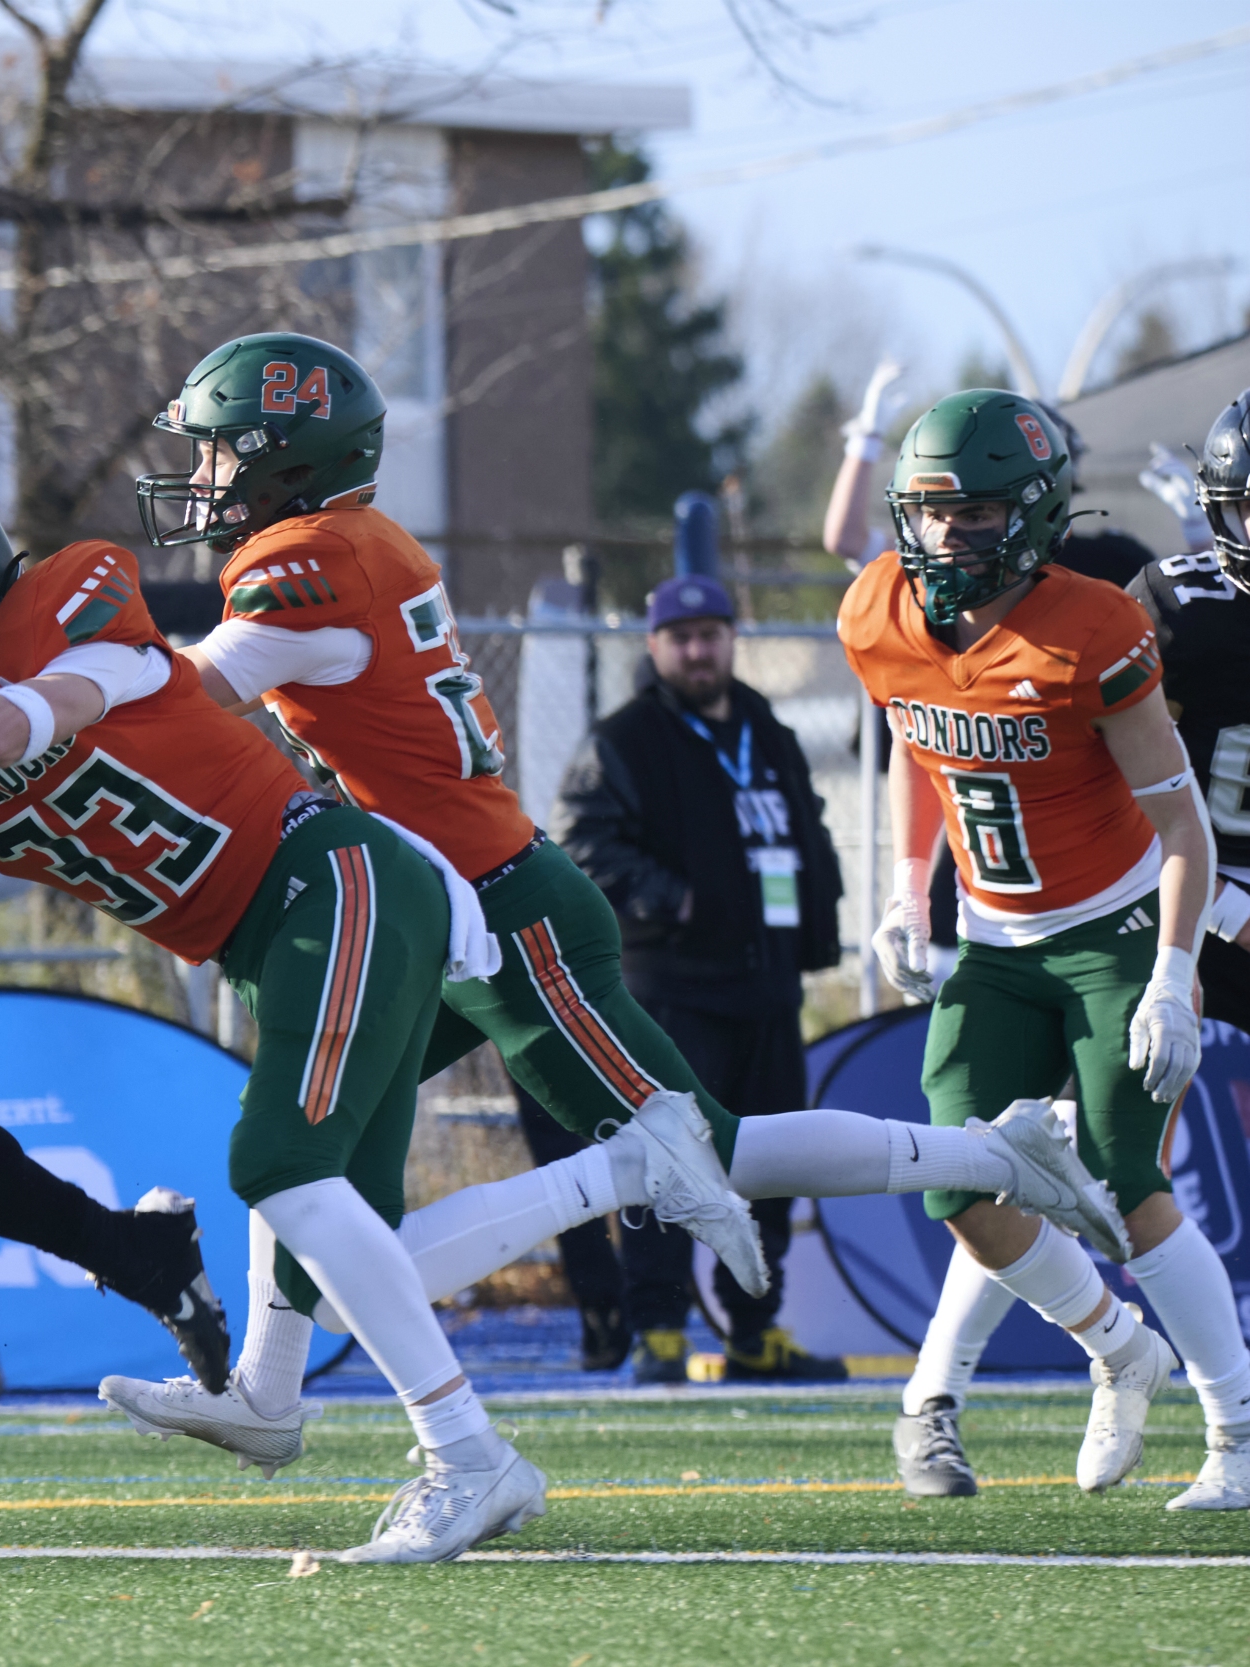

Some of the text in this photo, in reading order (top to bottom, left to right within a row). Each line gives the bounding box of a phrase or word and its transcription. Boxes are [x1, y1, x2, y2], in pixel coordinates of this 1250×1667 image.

[261, 361, 332, 420] 24
[1014, 412, 1052, 462] 8
[1158, 550, 1238, 606] 87
[889, 696, 1052, 763] CONDORS
[940, 764, 1044, 895] 8
